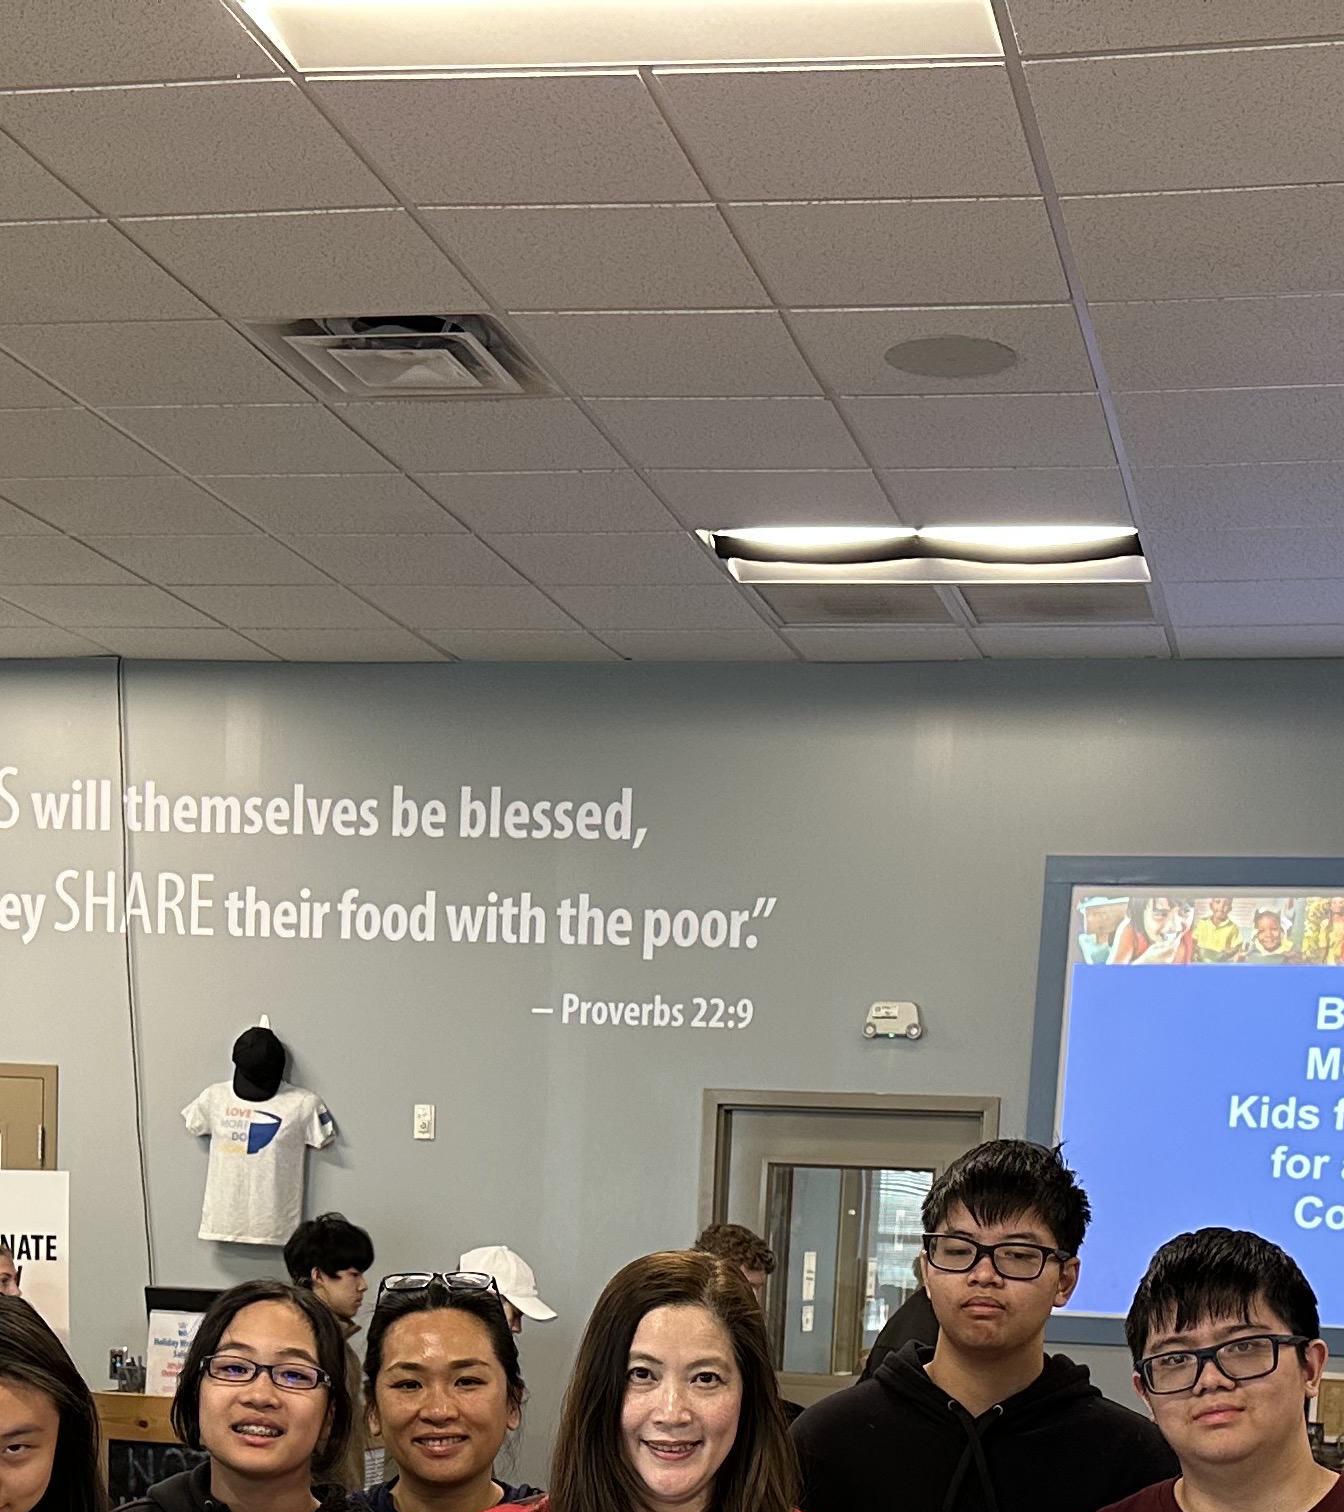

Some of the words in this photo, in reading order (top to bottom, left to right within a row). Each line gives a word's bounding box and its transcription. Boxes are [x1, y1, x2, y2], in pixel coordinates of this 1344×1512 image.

[30, 779, 111, 831] will
[123, 772, 379, 838] themselves
[391, 785, 446, 838] be
[459, 786, 648, 849] blessed,
[54, 869, 214, 936] SHARE
[224, 885, 331, 939] their
[337, 888, 436, 942] food
[445, 891, 546, 944] with
[556, 893, 633, 946] the
[562, 993, 684, 1027] Proverbs
[690, 997, 754, 1029] 22:9
[1229, 1095, 1320, 1130] Kids
[1271, 1145, 1331, 1180] for
